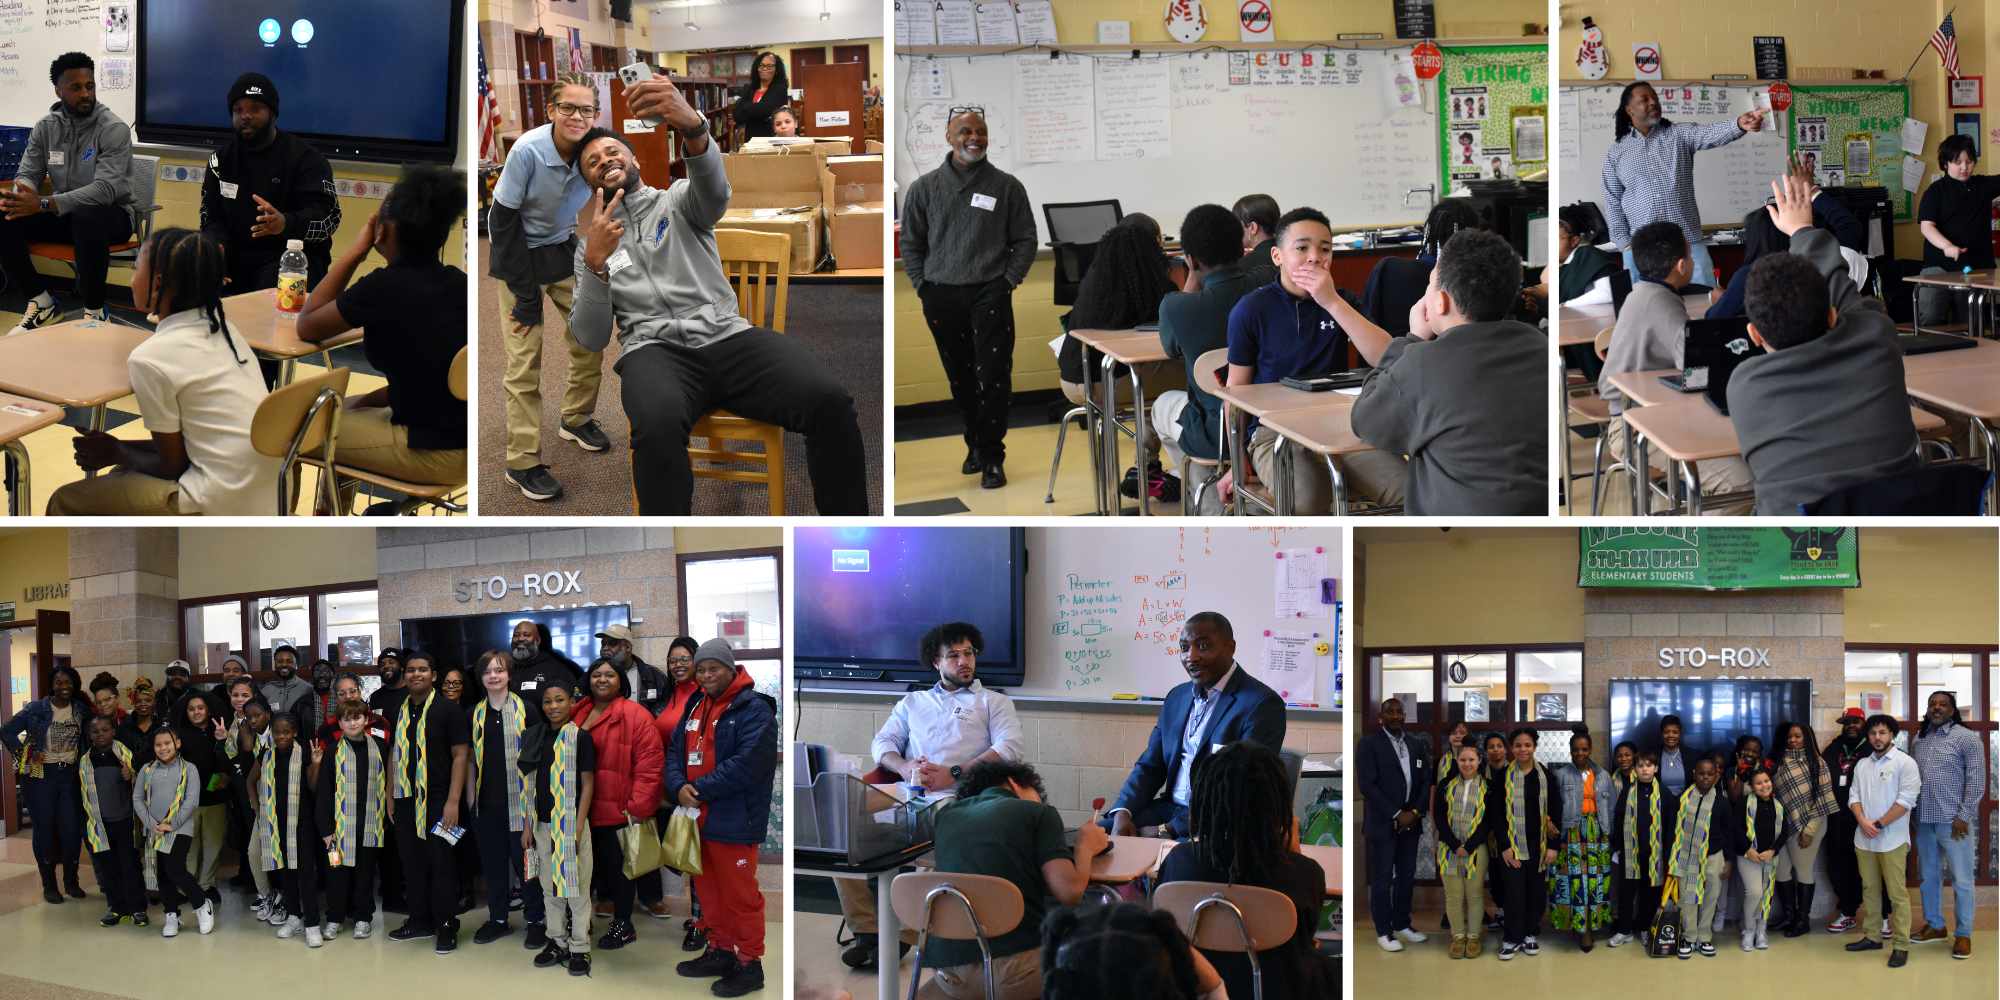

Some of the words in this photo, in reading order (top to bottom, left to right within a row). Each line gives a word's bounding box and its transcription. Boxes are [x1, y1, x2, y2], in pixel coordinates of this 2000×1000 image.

[1241, 11, 1270, 22] WHINING
[1413, 54, 1441, 68] STARTS
[1635, 54, 1660, 67] WHINING
[1179, 66, 1200, 76] MATH
[1462, 65, 1532, 84] VIKING
[1801, 68, 1821, 79] MS.
[1825, 68, 1847, 79] RAY
[1185, 98, 1212, 108] ALEKS
[1769, 91, 1791, 103] STARTS
[1244, 109, 1261, 118] Test
[1807, 101, 1860, 116] VIKING
[1859, 115, 1900, 132] NEWS
[1587, 526, 1698, 548] WELCOME
[846, 557, 865, 566] Signal
[1587, 549, 1649, 569] STO-ROX
[1650, 549, 1699, 569] UPPER
[1066, 573, 1114, 591] Perimeter
[1165, 575, 1182, 589] AREA
[1591, 571, 1647, 580] ELEMENTARY
[1650, 571, 1695, 580] STUDENTS
[1780, 574, 1790, 582] Every
[454, 570, 583, 603] STO-ROX
[1072, 594, 1086, 605] Add
[1086, 597, 1094, 605] up
[1104, 593, 1123, 603] sides
[1142, 597, 1149, 611] A
[1156, 599, 1164, 610] L
[1172, 597, 1185, 608] W
[1138, 613, 1146, 627] A
[1134, 631, 1143, 641] A
[1153, 630, 1167, 645] 50
[1658, 646, 1771, 669] STO-ROX
[1080, 678, 1090, 686] 30
